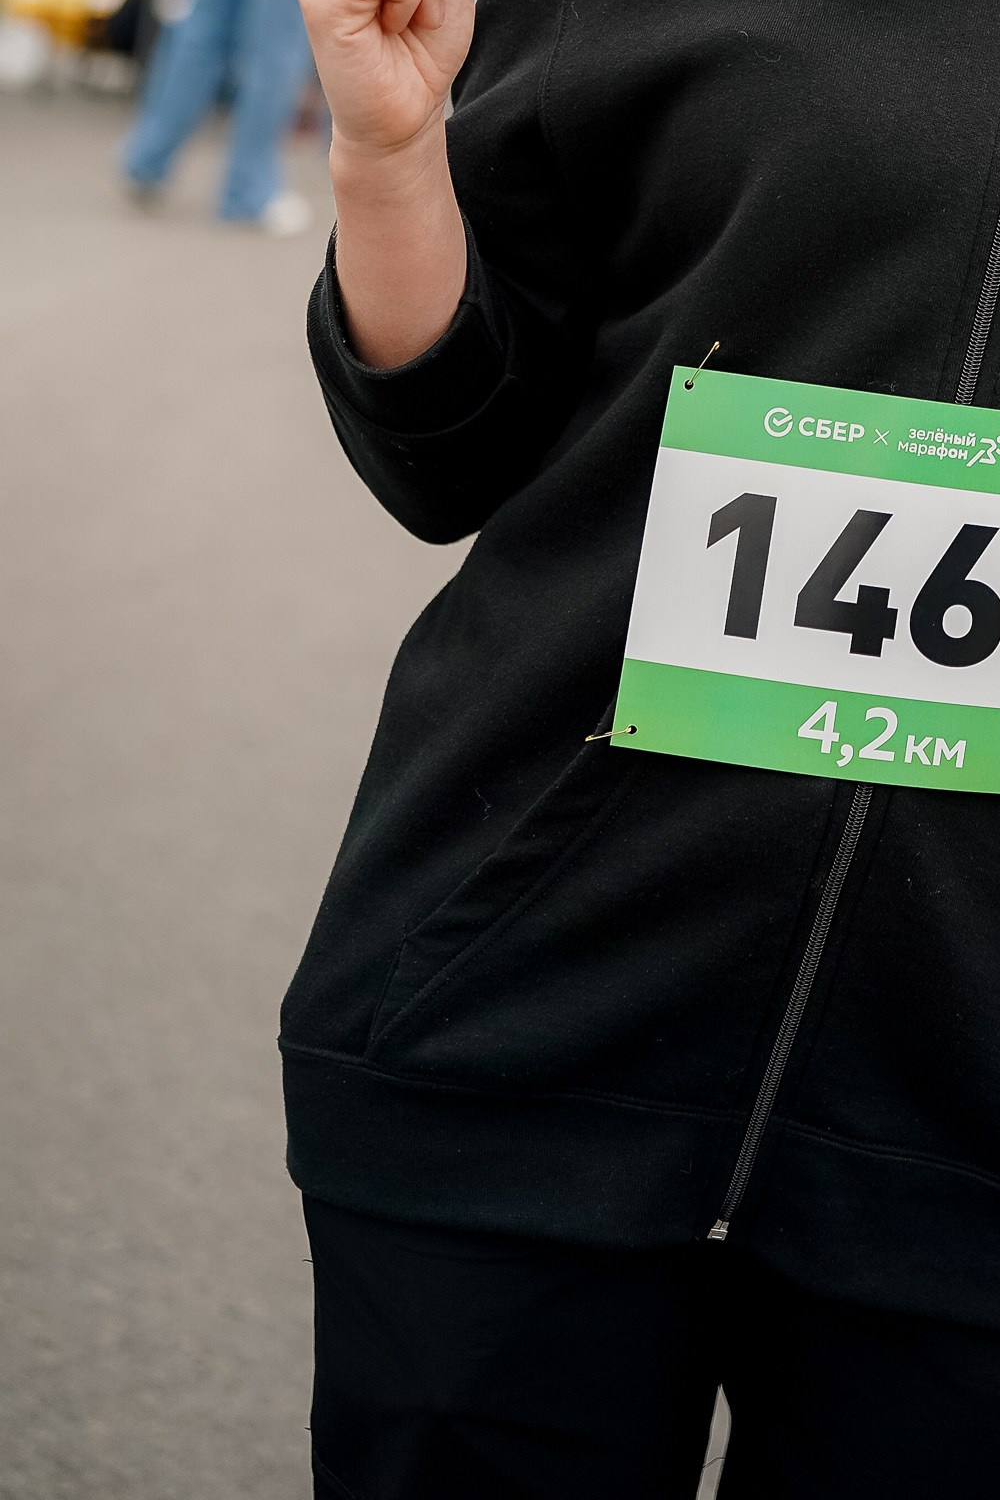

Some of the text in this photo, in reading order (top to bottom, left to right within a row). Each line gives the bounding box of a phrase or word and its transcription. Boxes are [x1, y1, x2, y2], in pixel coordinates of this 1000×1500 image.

[798, 416, 865, 443] СБЕР
[908, 427, 977, 447] зелёный
[897, 440, 969, 460] марафон
